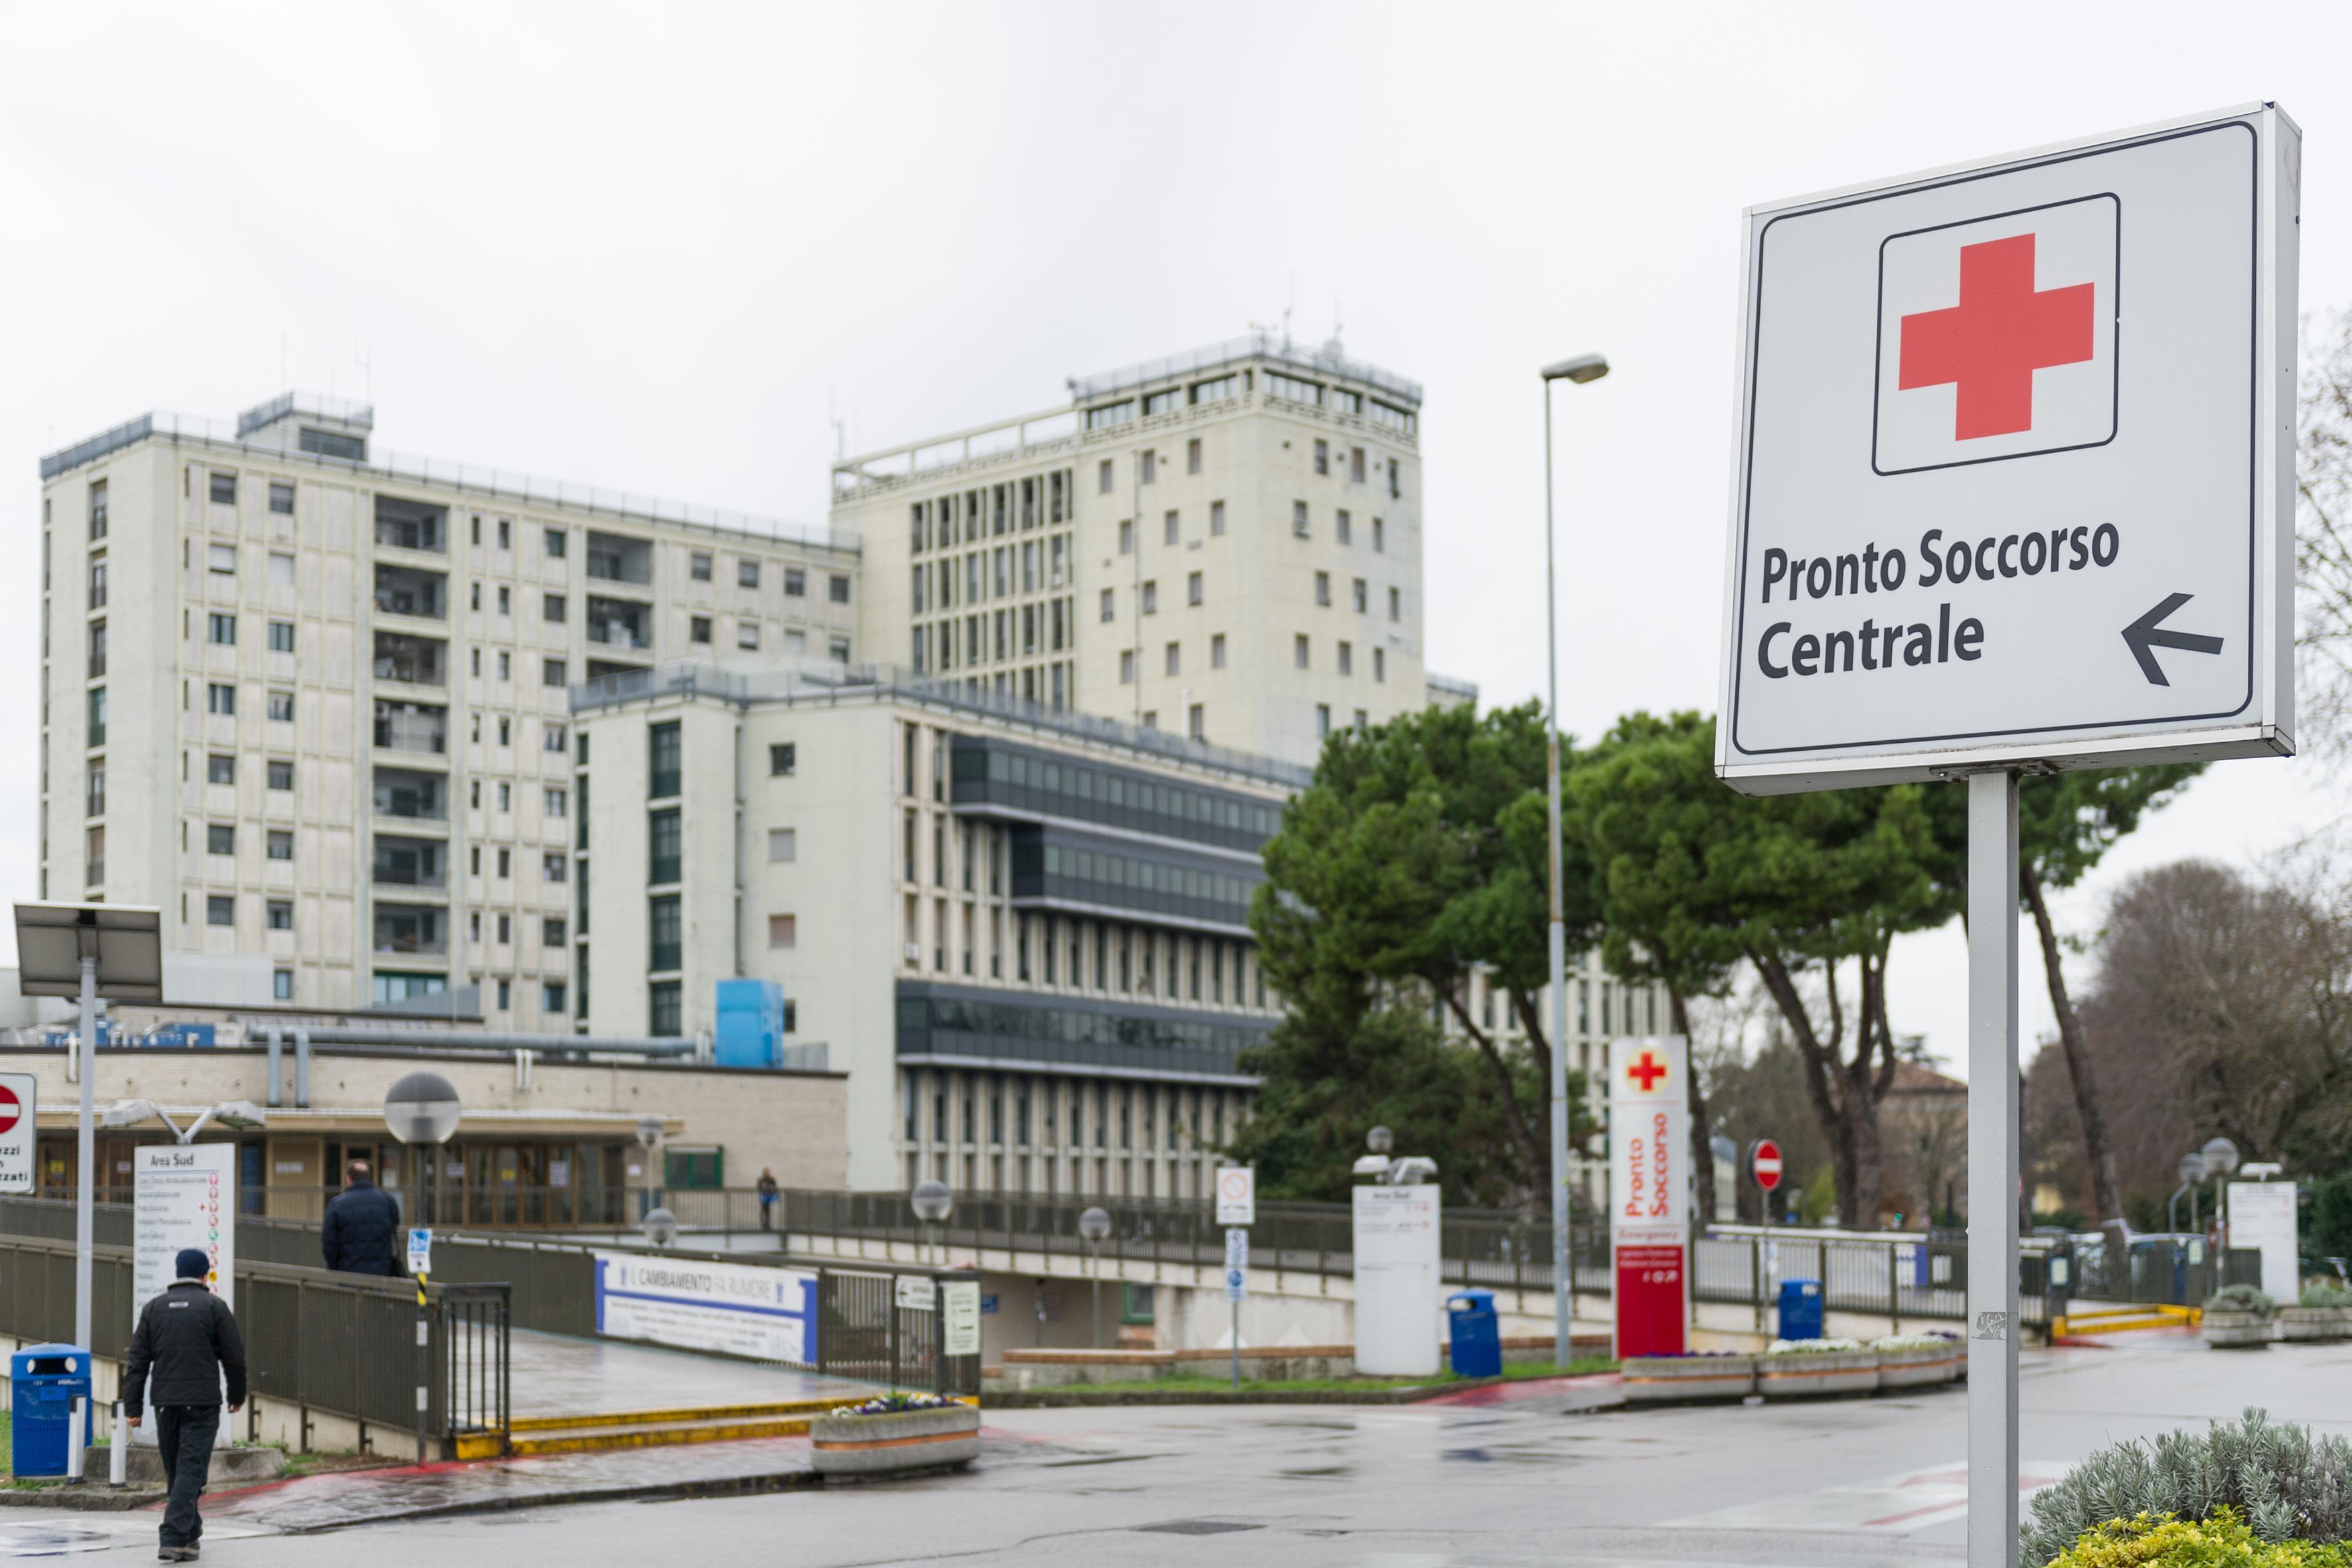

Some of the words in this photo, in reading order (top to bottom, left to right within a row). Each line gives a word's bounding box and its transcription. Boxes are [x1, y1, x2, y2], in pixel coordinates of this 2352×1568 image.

[1762, 542, 1906, 603] Pronto
[1919, 522, 2120, 587] Soccorso
[1758, 603, 1984, 678] Centrale
[150, 1154, 170, 1166] Area
[173, 1152, 194, 1166] Sud
[1625, 1137, 1644, 1217] Pronto
[1649, 1112, 1668, 1217] Soccorso
[639, 1267, 711, 1293] CAMBIAMENTO
